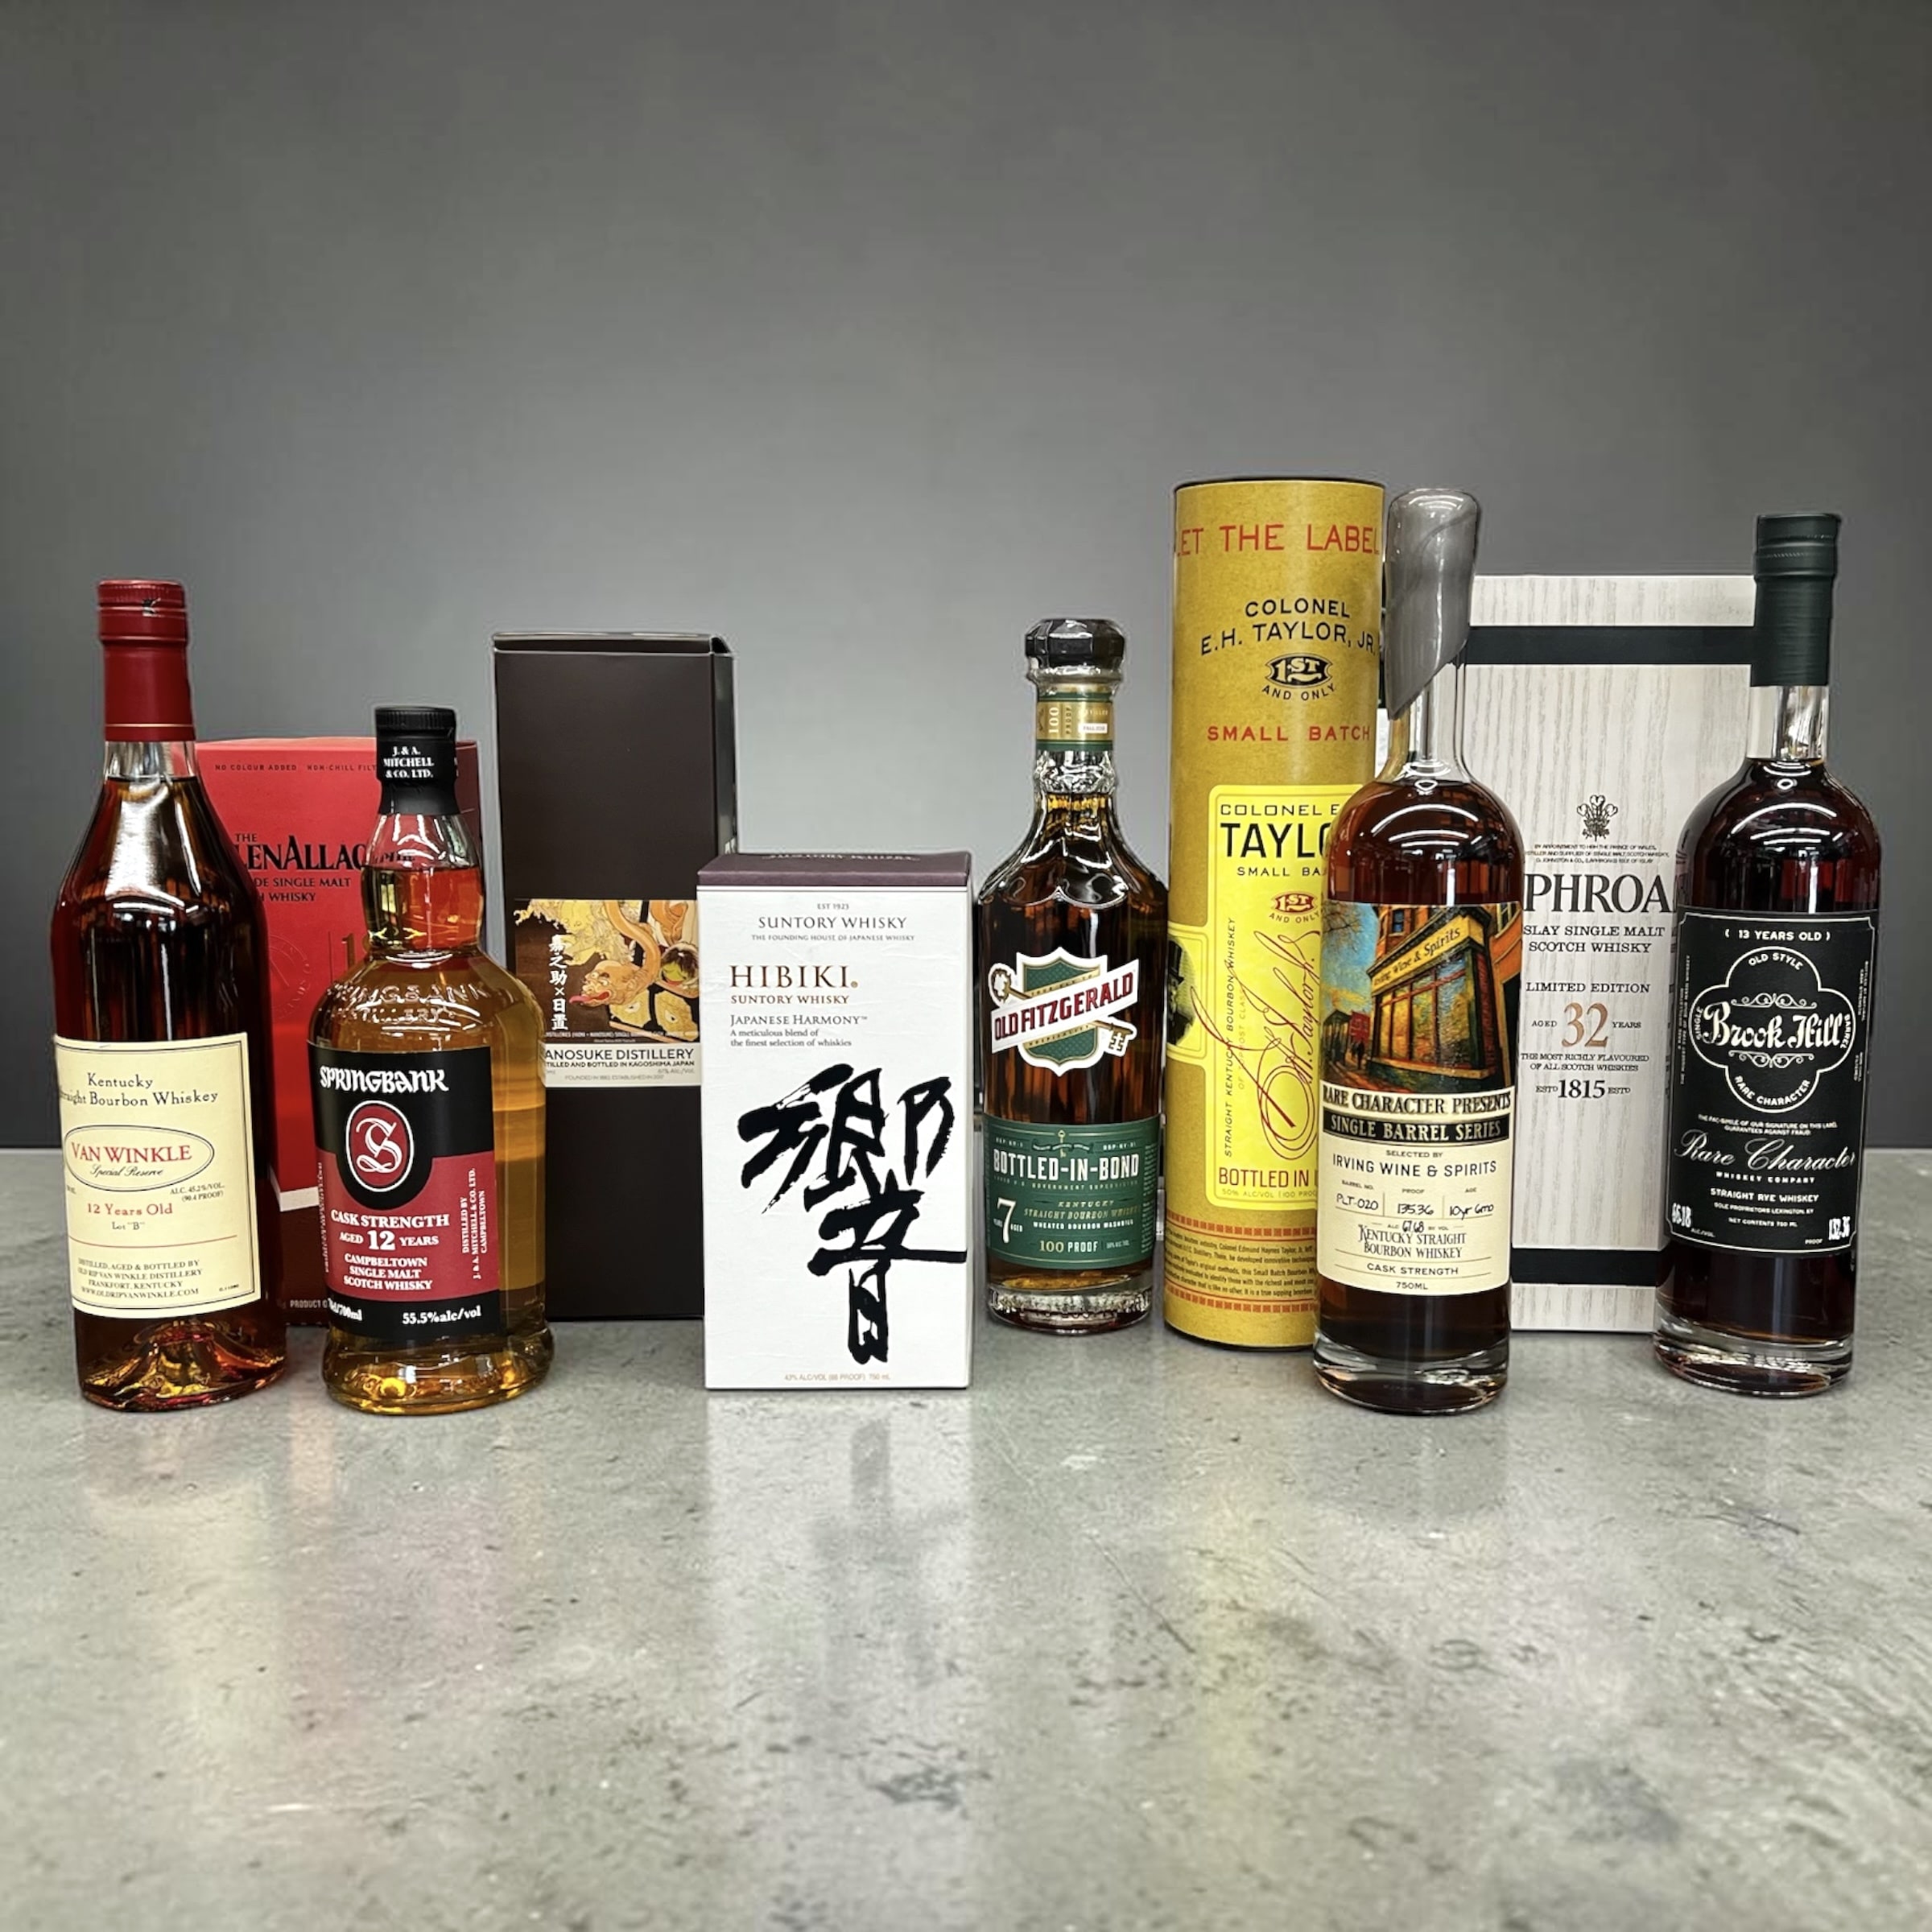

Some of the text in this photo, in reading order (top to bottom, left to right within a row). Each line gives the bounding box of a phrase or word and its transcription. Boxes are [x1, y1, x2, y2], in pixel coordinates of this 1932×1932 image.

[1177, 523, 1380, 556] ET THE LABEL
[1245, 597, 1350, 618] COLONEL
[1200, 628, 1243, 656] E.H.
[1253, 621, 1352, 648] TAYLOR,
[1262, 683, 1335, 701] AND ONLY
[1048, 707, 1059, 734] 100
[1208, 725, 1370, 741] SMALL BATCH
[401, 747, 408, 755] &
[411, 746, 421, 755] A.
[383, 757, 435, 767] MITCHELL
[386, 770, 393, 778] &
[411, 769, 434, 778] LTD.
[1220, 803, 1323, 816] COLONEL
[1237, 866, 1290, 877] SMALL
[273, 877, 316, 886] SINGLE
[320, 877, 351, 886] MALT
[269, 892, 316, 902] WHISKY
[1524, 873, 1676, 913] PHROA
[758, 916, 907, 929] SUNTORY WHISKY
[1524, 925, 1666, 936] SLAY SINGLE MALT
[1227, 917, 1236, 969] WHISKEY
[1739, 930, 1822, 941] 13 YEARS OLD
[1529, 942, 1652, 953] SCOTCH WHISKY
[1748, 952, 1803, 970] OLD STYLE
[1525, 982, 1651, 993] LIMITED EDITION
[731, 995, 849, 1004] SUNTORY WHISKY
[995, 972, 1134, 1041] OLD FITZGERALD
[1226, 974, 1234, 1031] BOURBON
[1561, 1002, 1608, 1047] 32
[1694, 1006, 1704, 1041] SINGLE
[1701, 1001, 1843, 1049] Brook Hill
[1839, 1013, 1851, 1049] BARREL
[738, 1029, 783, 1037] meticulous
[785, 1029, 808, 1037] blend
[806, 1038, 815, 1046] of
[818, 1038, 852, 1046] whiskies
[545, 1048, 694, 1060] ANOSUKE DISTILLERY
[87, 1072, 153, 1089] Kentucky
[1558, 1080, 1606, 1099] 1815
[1735, 1075, 1811, 1105] RARE CHARACTER
[90, 1090, 218, 1106] Bourbon Whiskey
[1352, 1090, 1444, 1114] CHARACTER
[1452, 1090, 1511, 1114] PRESENTS
[1224, 1100, 1232, 1158] STRAIGHT
[1331, 1114, 1501, 1141] SINGLE BARREL SERIES
[72, 1142, 192, 1163] VAN WINKLE
[1386, 1150, 1430, 1158] SELECTED
[1674, 1129, 1856, 1170] Rare Character
[90, 1164, 164, 1178] Special Reserve
[993, 1149, 1139, 1182] BOTTLED-IN-BOND
[1333, 1153, 1496, 1177] IRVING WINE & SPIRITS
[1219, 1167, 1289, 1188] BOTTLED
[1294, 1169, 1309, 1187] IN
[1715, 1171, 1762, 1182] WHISKEY
[1711, 1187, 1819, 1203] STRAIGHT RYE WHISKEY
[87, 1203, 173, 1216] 12 Years Old
[1024, 1208, 1108, 1220] STRAIGHT BOURBON
[112, 1222, 126, 1230] Lot
[331, 1209, 450, 1228] CASK STRENGTH
[997, 1197, 1017, 1244] 7
[339, 1230, 439, 1250] AGED 12 YEARS
[1358, 1224, 1466, 1245] KENTUCKY STRAIGHT
[1039, 1240, 1064, 1253] 100
[1067, 1241, 1099, 1253] PROOF
[1364, 1241, 1463, 1259] BOURBON WHISKEY
[143, 1261, 186, 1270] BOTTLED
[345, 1253, 427, 1267] CAMPBELTOWN
[349, 1266, 421, 1279] SINGLE MALT
[1367, 1263, 1459, 1276] CASK STRENGTH
[344, 1276, 433, 1291] SCOTCH WHISKY
[1397, 1282, 1429, 1290] 750ML
